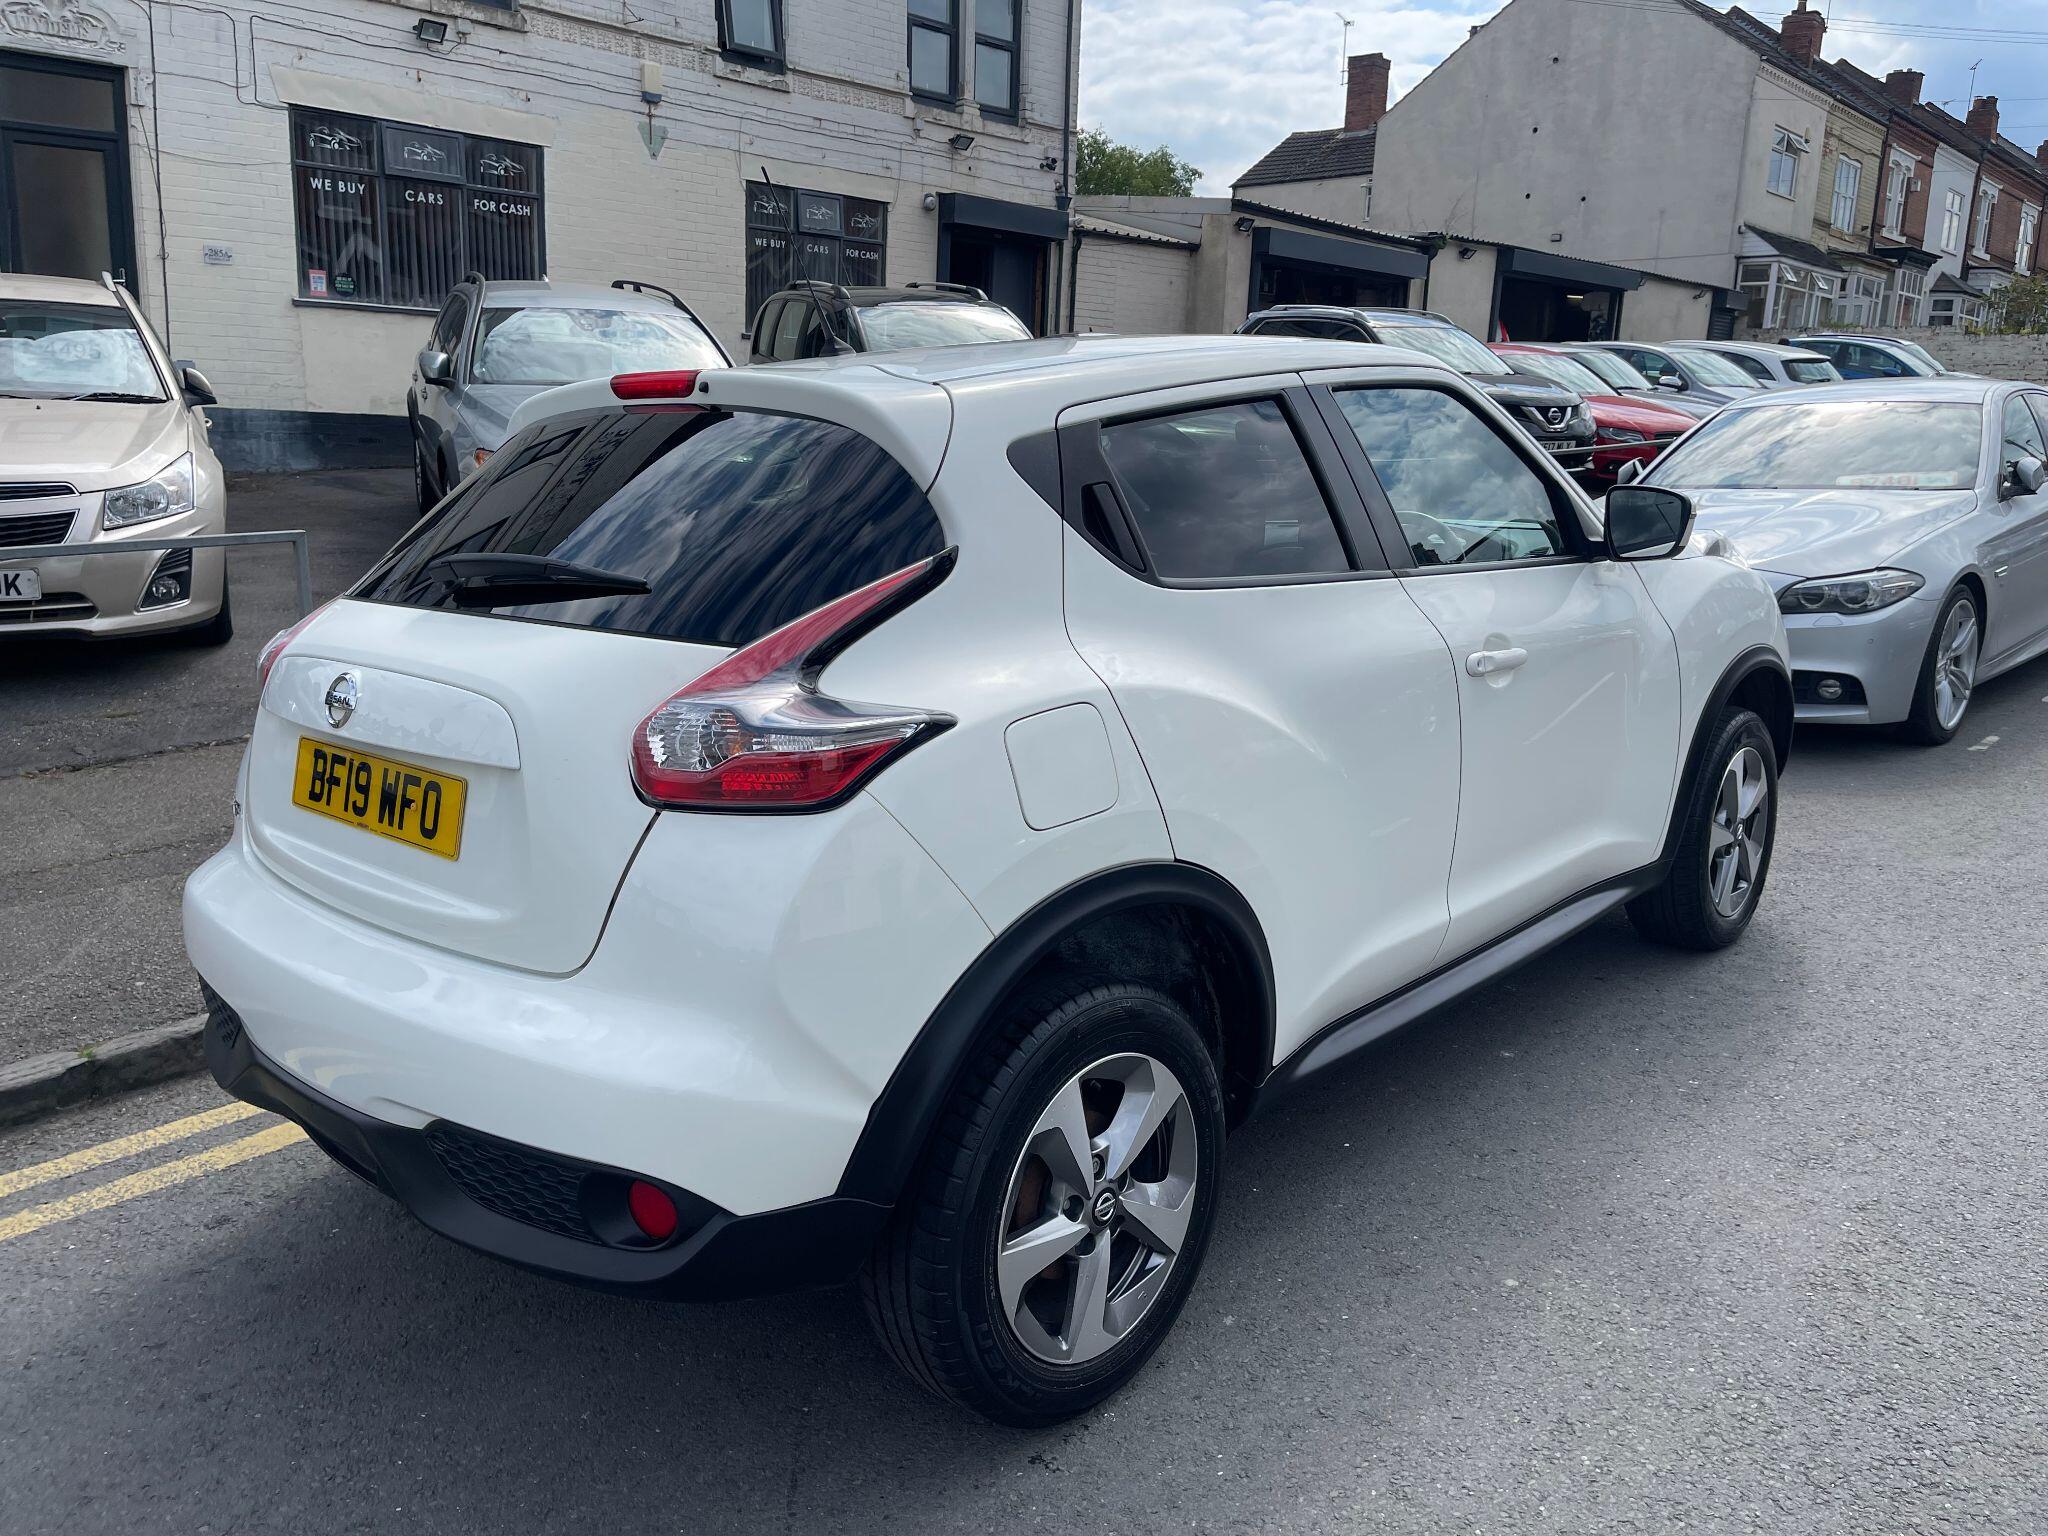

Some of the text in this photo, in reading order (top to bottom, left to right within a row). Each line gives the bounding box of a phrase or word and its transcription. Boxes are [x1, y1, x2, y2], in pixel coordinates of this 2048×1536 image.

[310, 177, 531, 217] WE BUY CARS FOR CASH
[755, 238, 879, 260] WE BUY CARS FOR CASH
[309, 748, 442, 840] BF19 WFO
